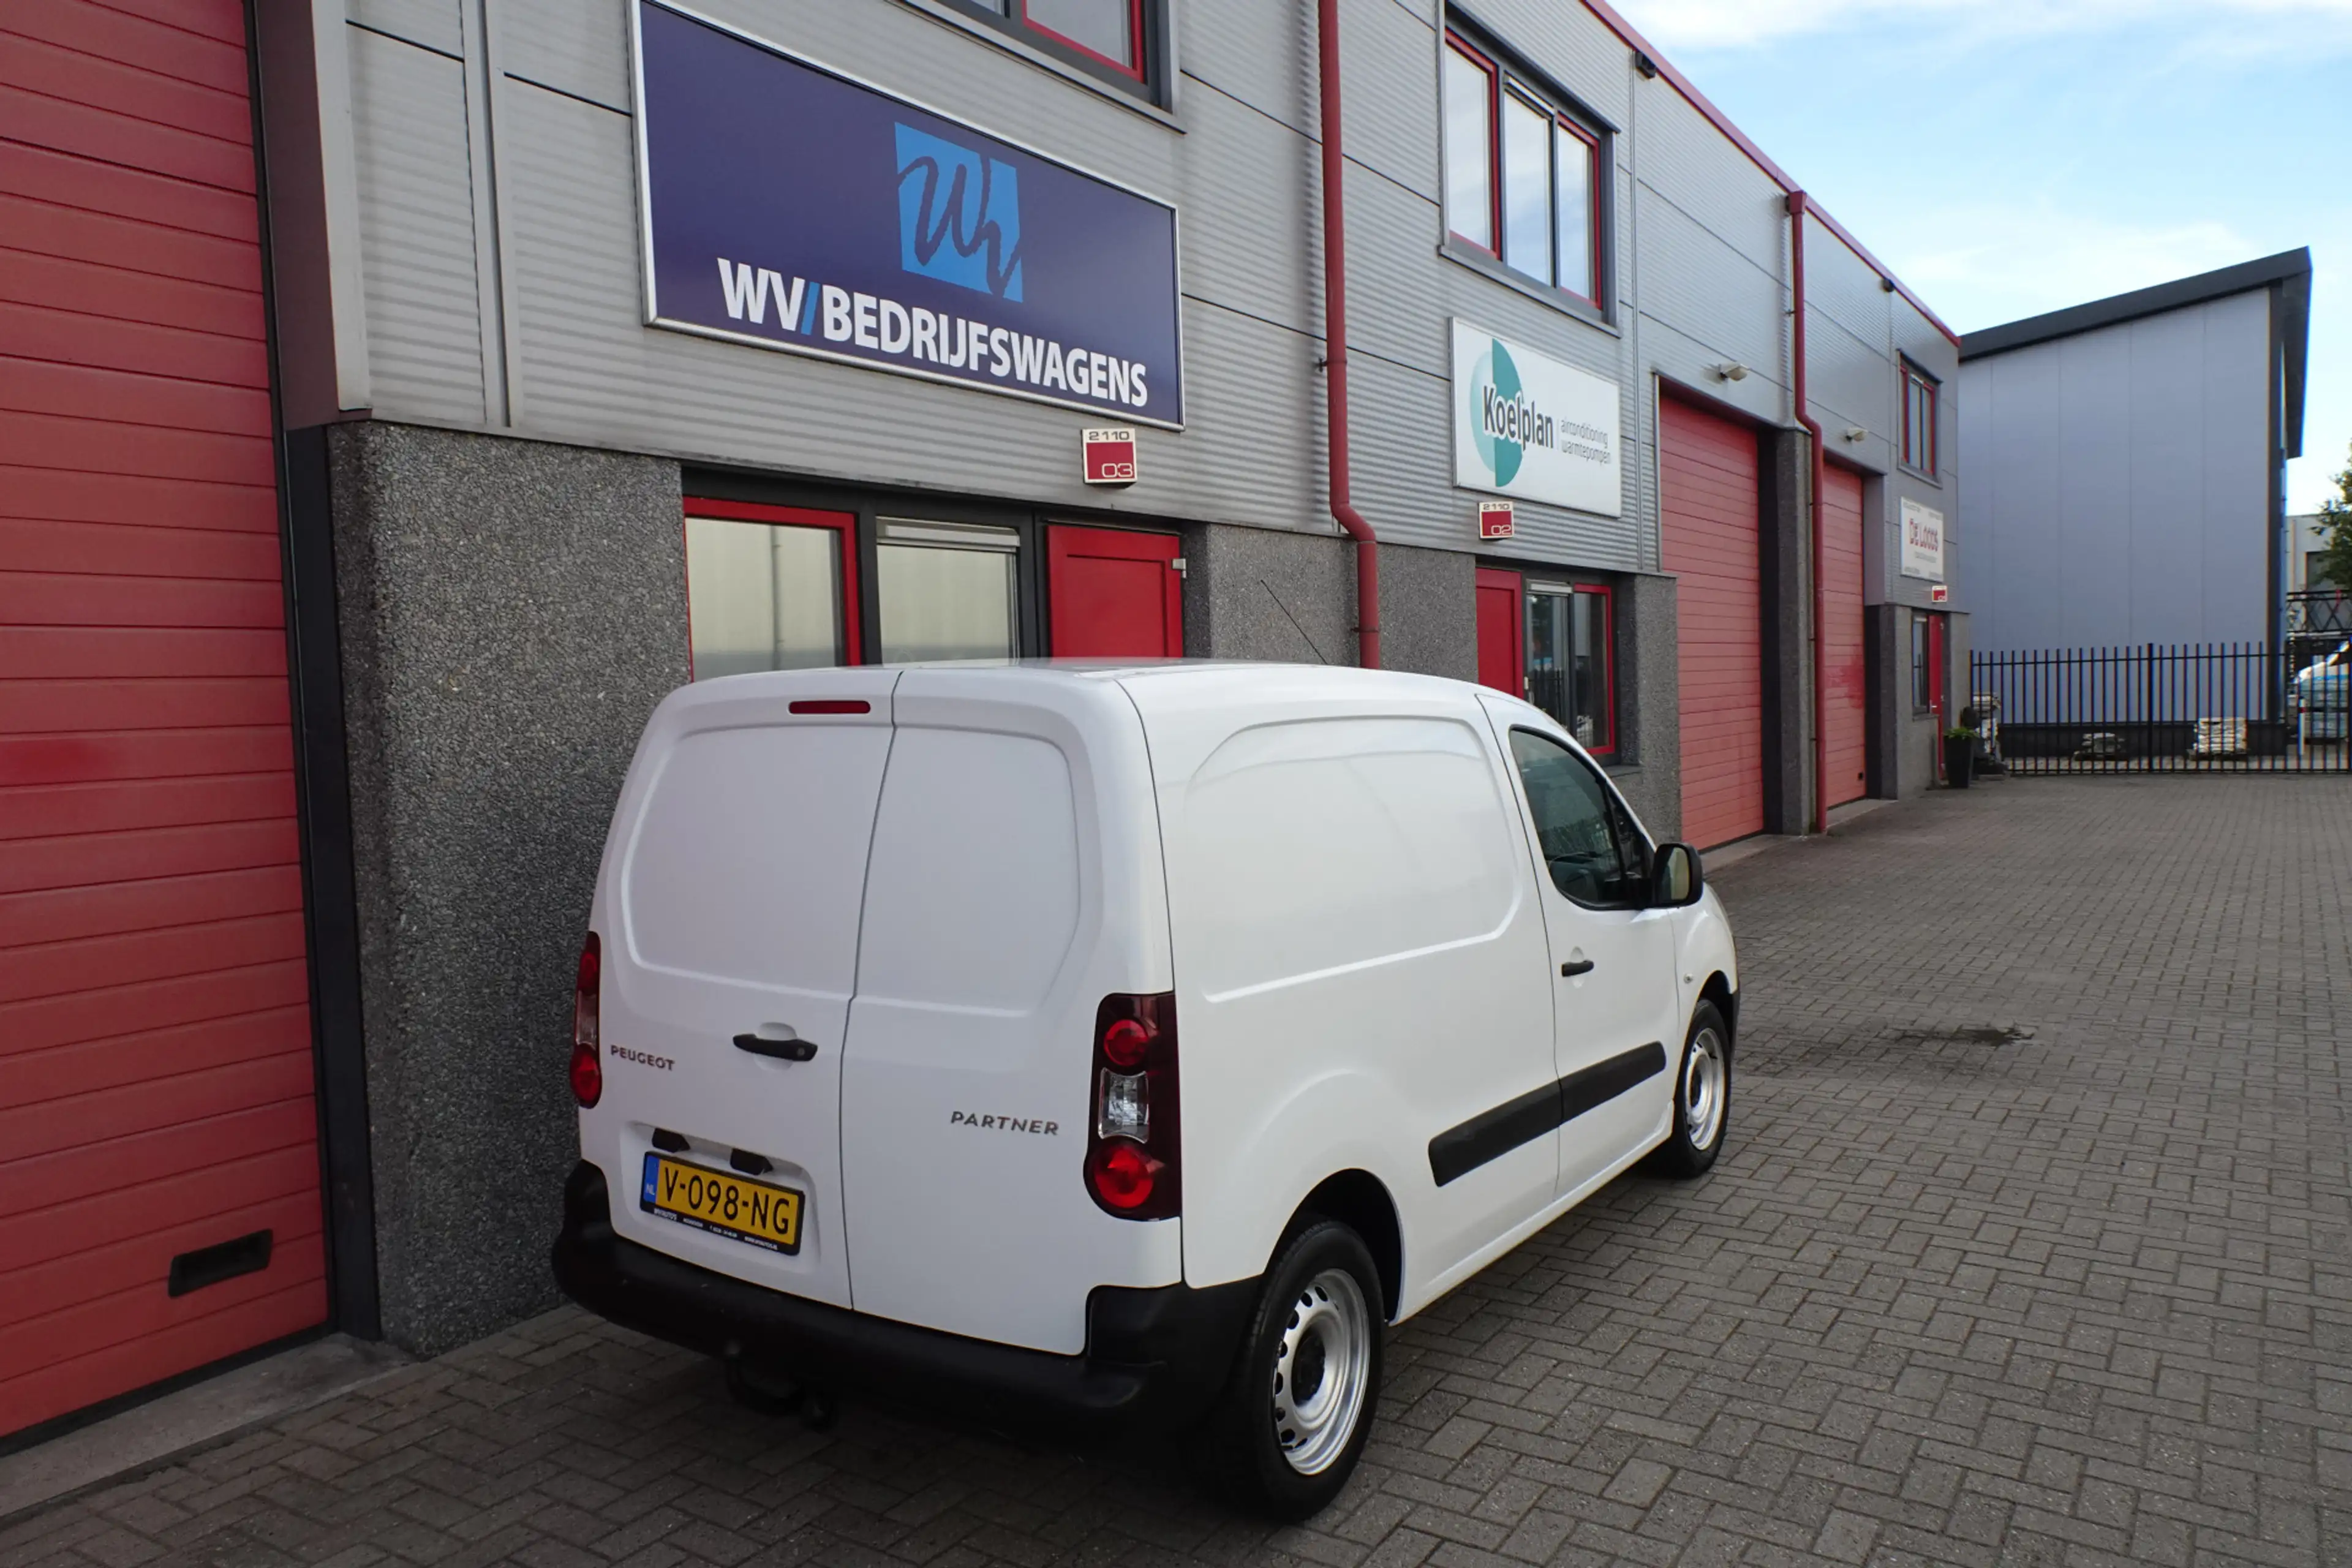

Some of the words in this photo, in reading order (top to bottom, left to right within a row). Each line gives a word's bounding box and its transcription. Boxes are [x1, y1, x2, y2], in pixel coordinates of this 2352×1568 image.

[1483, 386, 1553, 451] Koelplan
[1089, 431, 1129, 440] 2110
[1561, 417, 1608, 448] airconditioning
[1561, 439, 1611, 466] warmtepompen
[1102, 463, 1133, 478] 03
[1491, 524, 1511, 535] 02
[611, 1044, 675, 1071] PEUGEOT
[950, 1110, 1059, 1136] PARTNER
[646, 1183, 655, 1196] NL
[665, 1166, 790, 1235] V-098-NG
